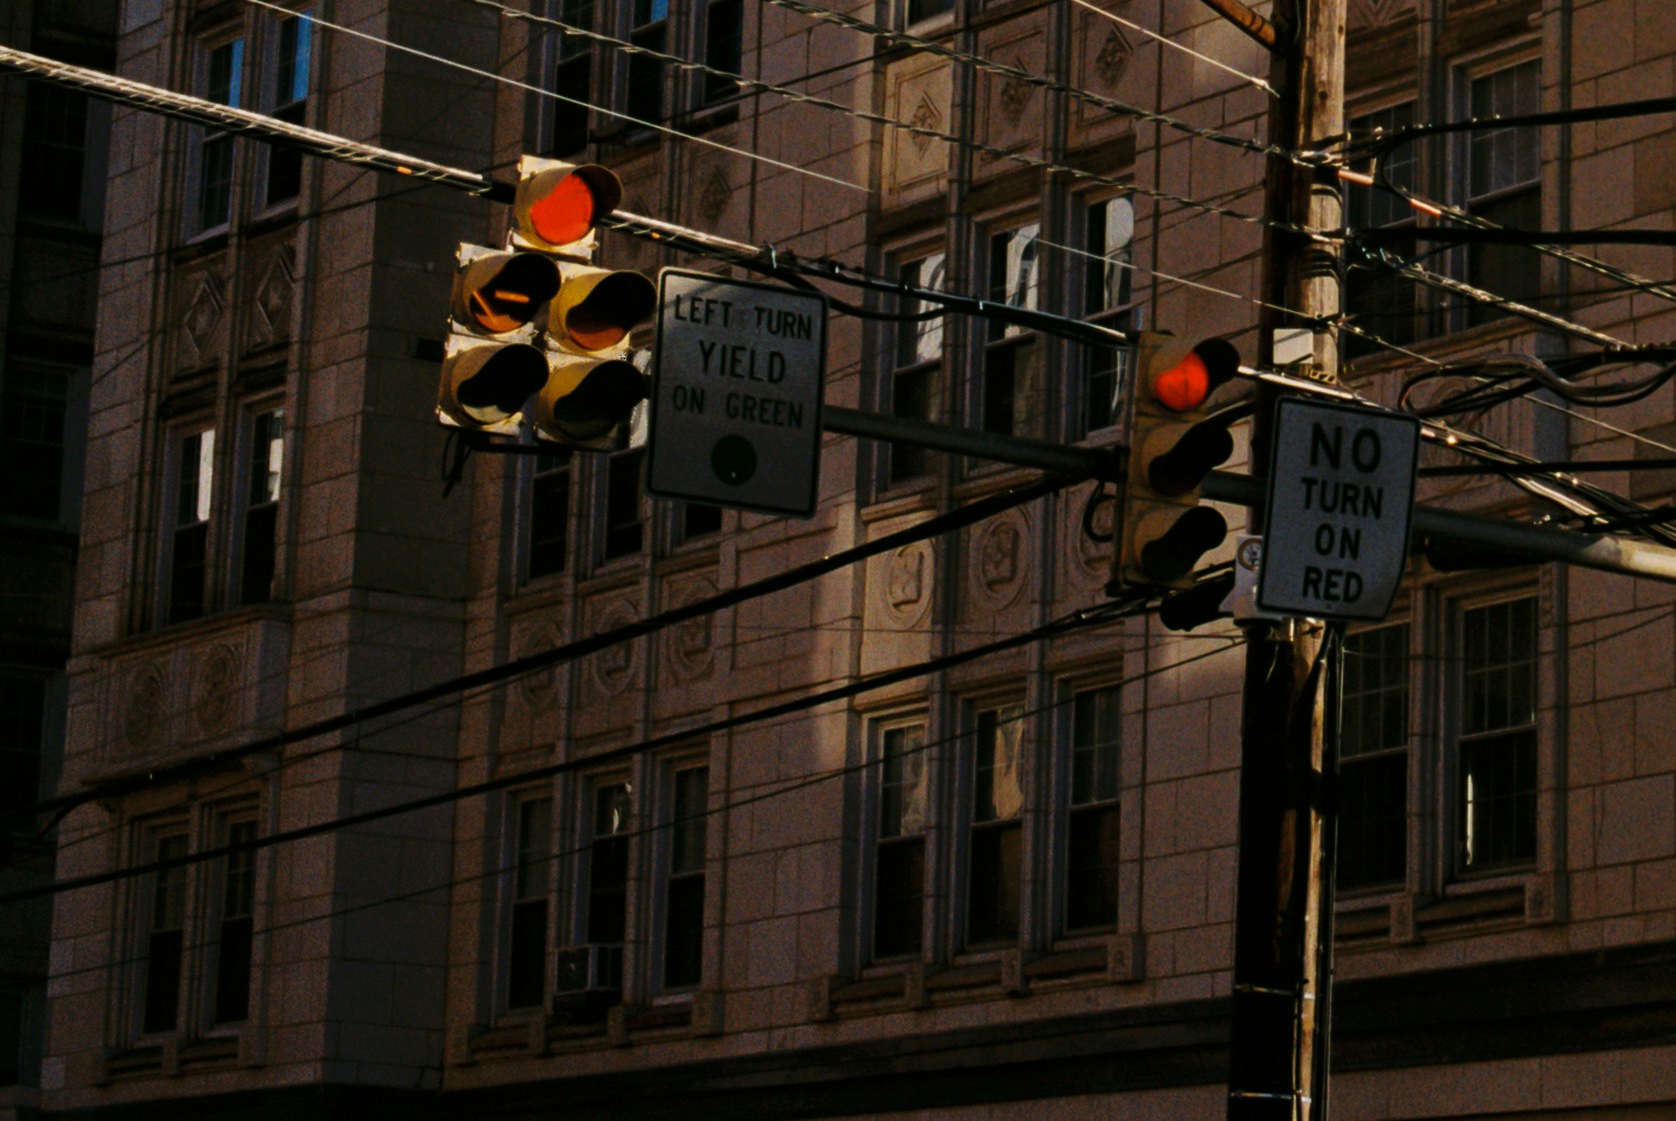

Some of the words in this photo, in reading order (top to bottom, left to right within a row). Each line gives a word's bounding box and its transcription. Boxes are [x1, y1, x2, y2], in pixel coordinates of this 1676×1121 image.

[674, 294, 732, 328] LEFT
[754, 306, 812, 340] TURN
[699, 340, 786, 383] YIELD
[672, 384, 705, 414] ON
[726, 393, 803, 427] GREEN
[1310, 422, 1382, 473] NO
[1302, 477, 1383, 519] TURN
[1314, 523, 1361, 560] ON
[1302, 566, 1363, 603] RED
